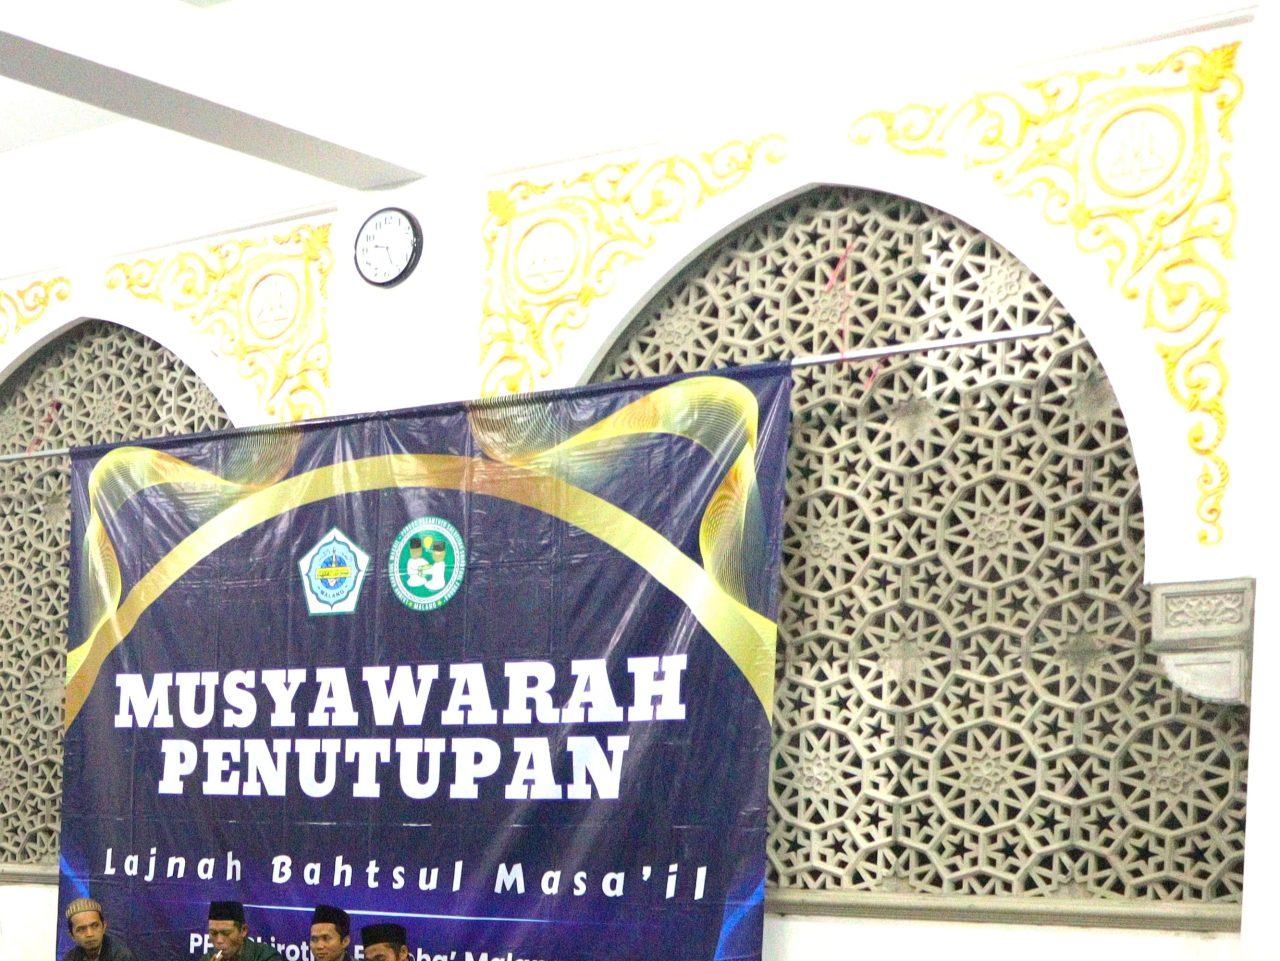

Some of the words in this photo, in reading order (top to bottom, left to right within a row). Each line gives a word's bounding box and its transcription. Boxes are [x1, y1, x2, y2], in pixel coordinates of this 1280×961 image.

[115, 654, 687, 728] MUSYAWARAH
[158, 735, 631, 800] PENUTUPAN
[103, 846, 242, 882] Lajnah
[271, 854, 463, 892] Bahtsul
[494, 862, 707, 901] Masa'il
